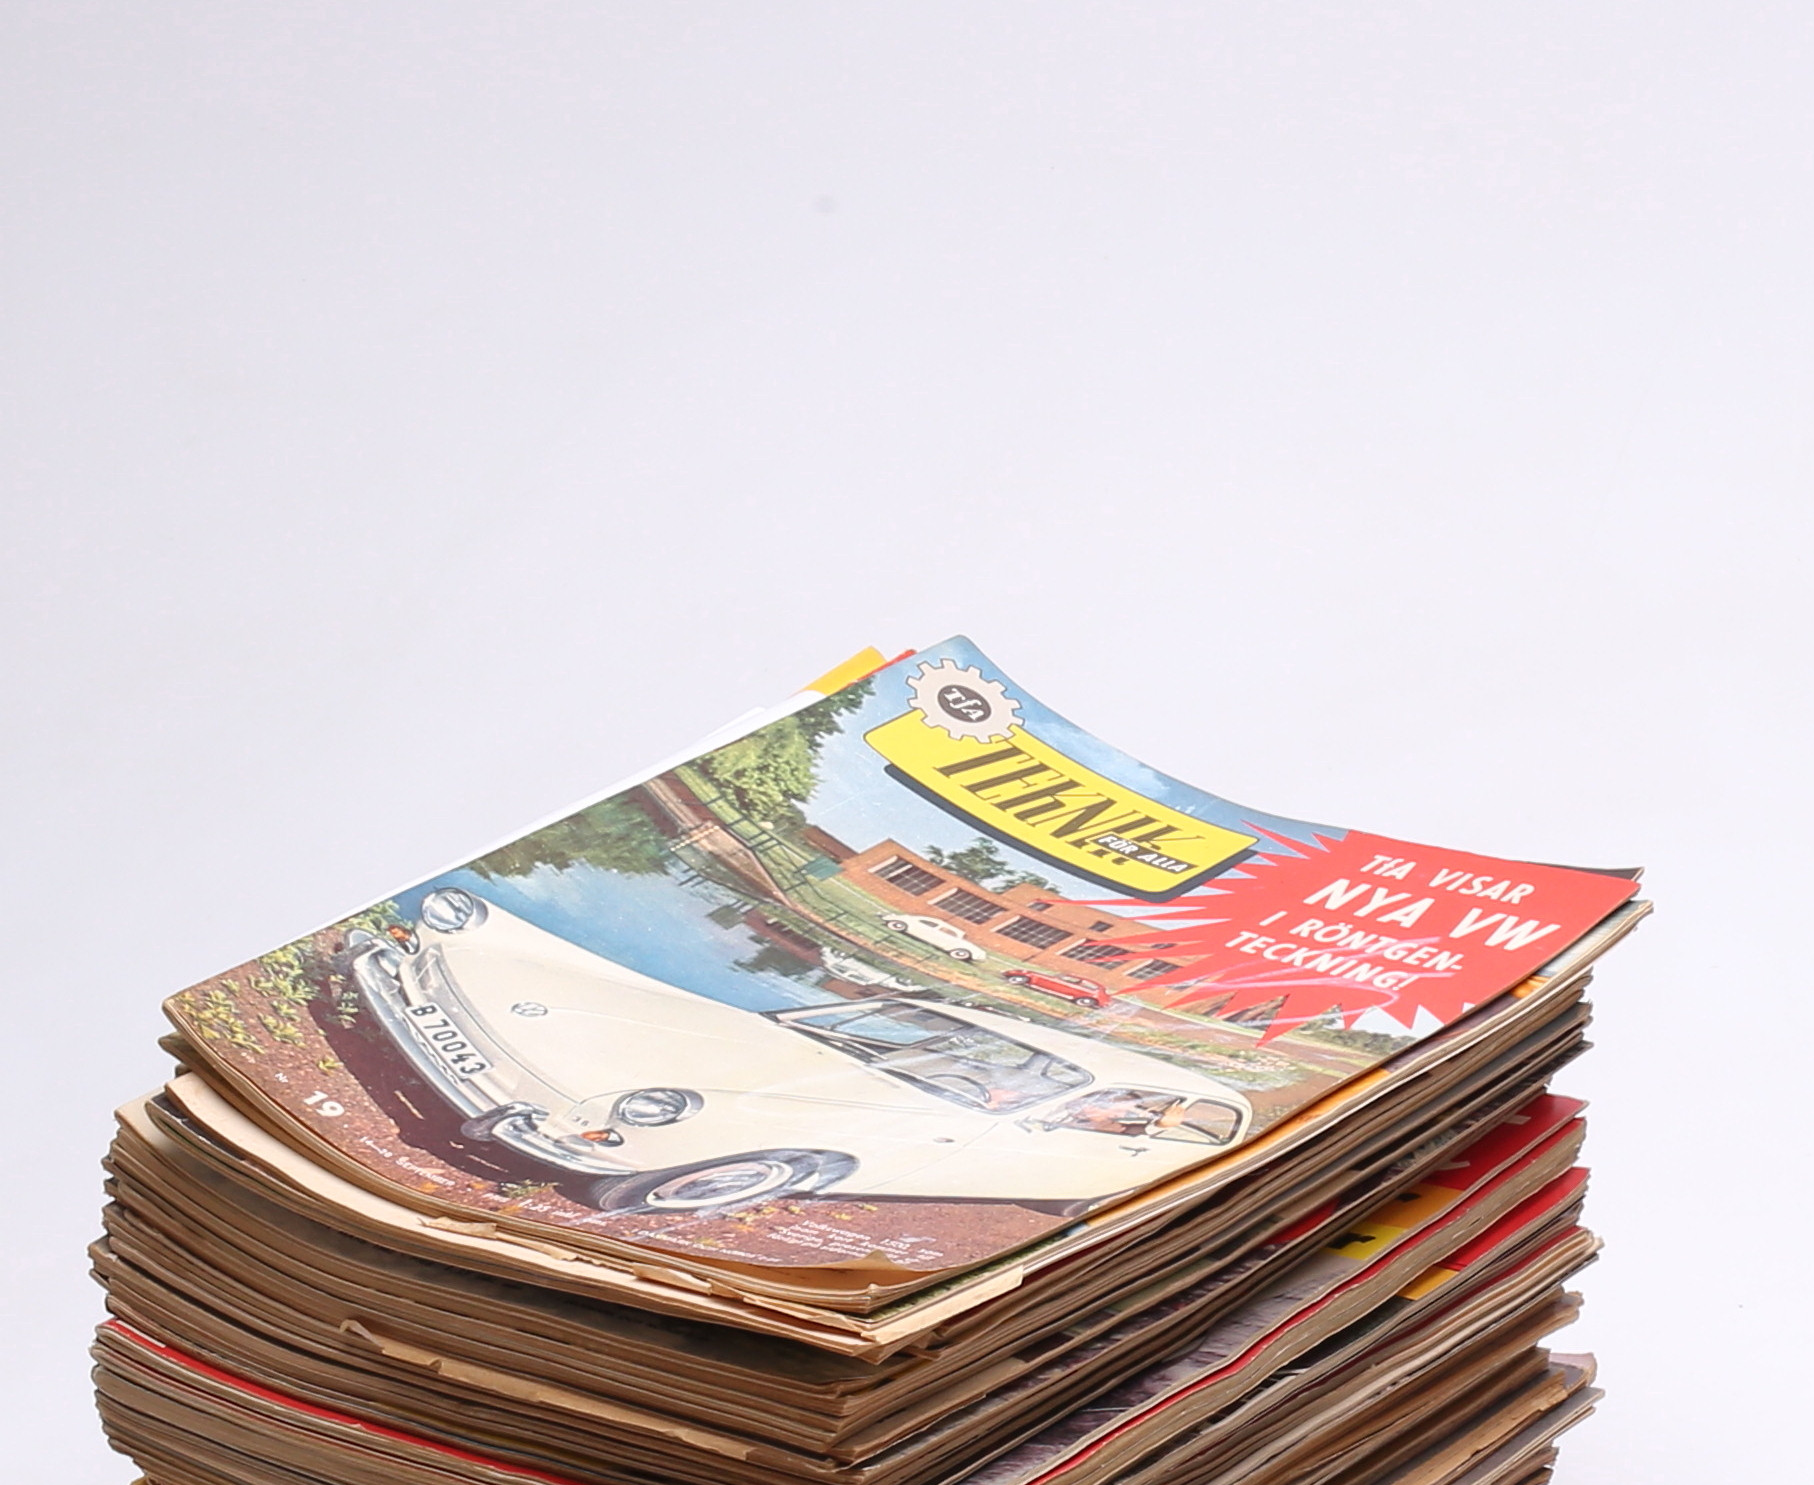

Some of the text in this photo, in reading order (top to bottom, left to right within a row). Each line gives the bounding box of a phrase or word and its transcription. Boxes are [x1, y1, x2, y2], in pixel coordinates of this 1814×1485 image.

[1099, 835, 1192, 874] FÖR ALLA
[1360, 854, 1536, 905] TfA VISAR
[1259, 911, 1464, 972] I RÖNTGEN-
[1302, 878, 1562, 951] NYA VW
[1224, 930, 1420, 991] TECKNING!
[410, 1004, 487, 1075] B 70043
[303, 1090, 345, 1117] 19
